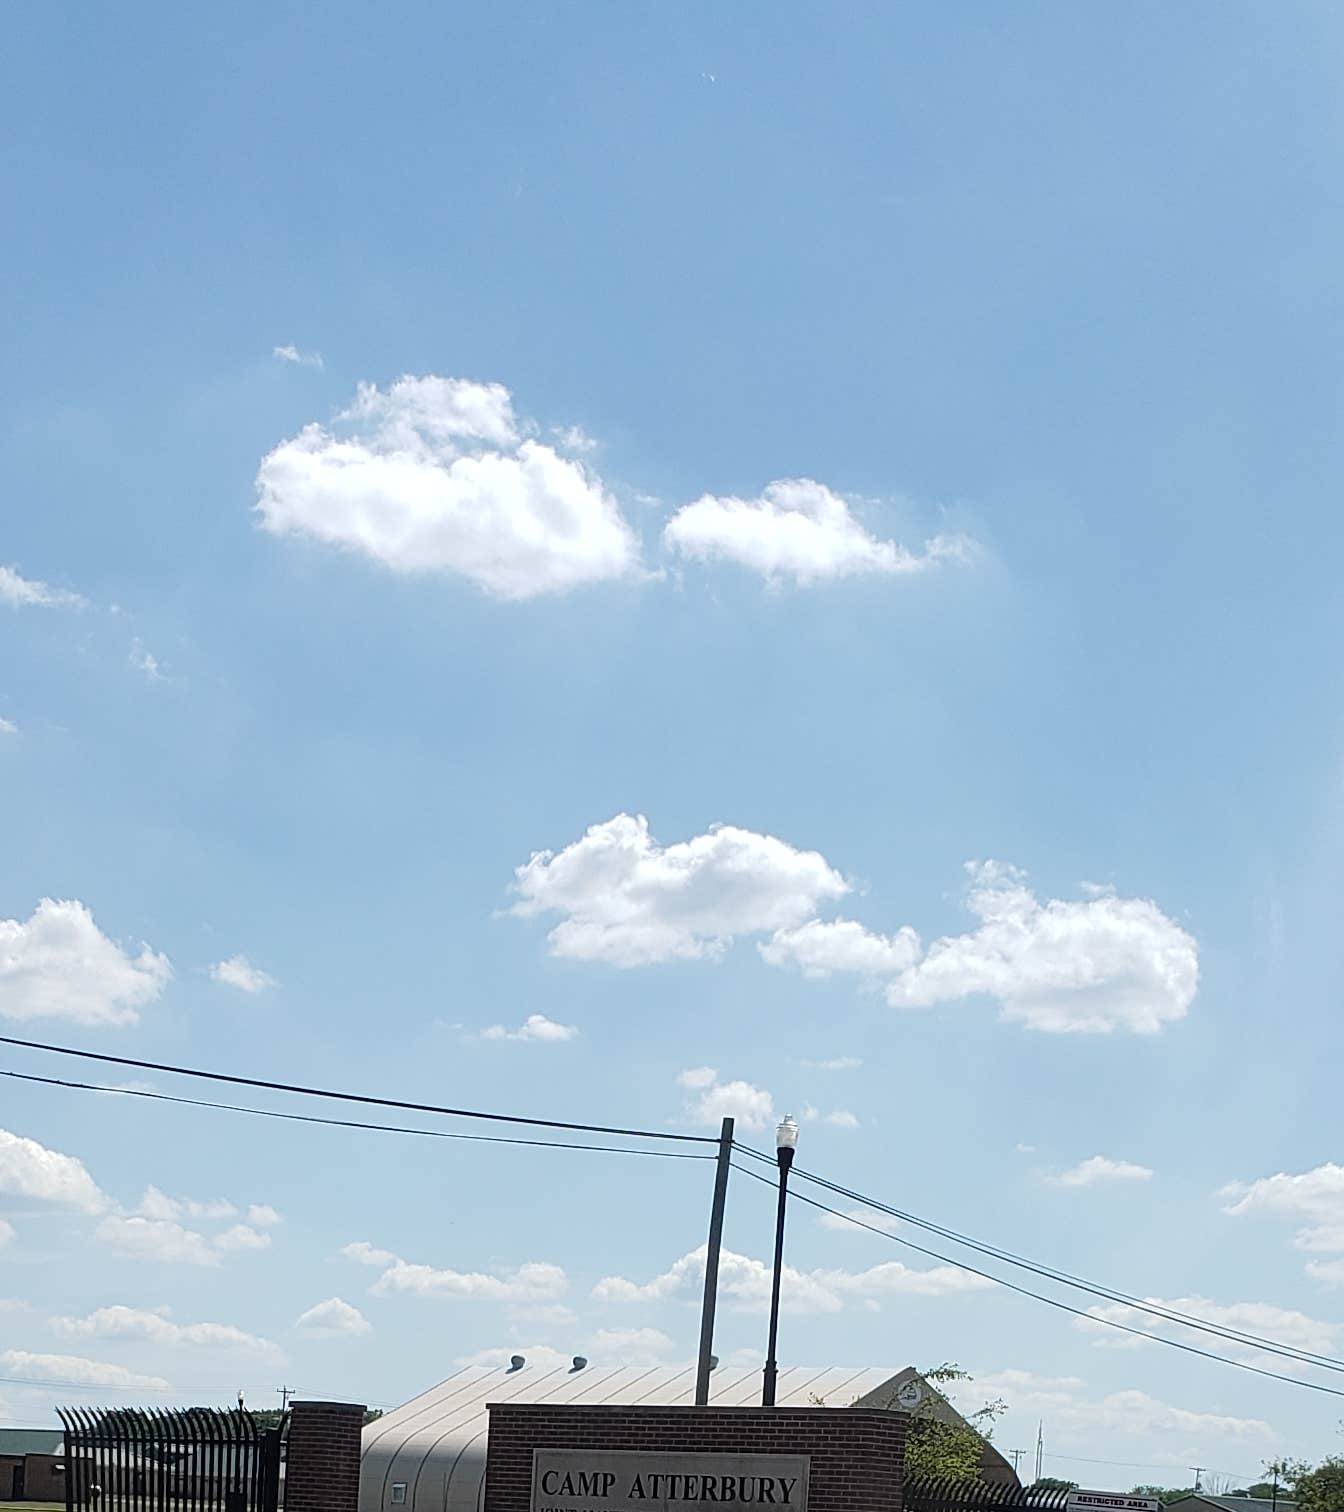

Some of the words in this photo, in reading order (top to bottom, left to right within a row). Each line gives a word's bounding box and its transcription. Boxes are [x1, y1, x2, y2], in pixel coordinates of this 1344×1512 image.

[541, 1470, 616, 1498] CAMP
[627, 1473, 798, 1504] ATTERBURY
[1077, 1495, 1125, 1506] RESTRICTED
[1126, 1500, 1148, 1508] AREA
